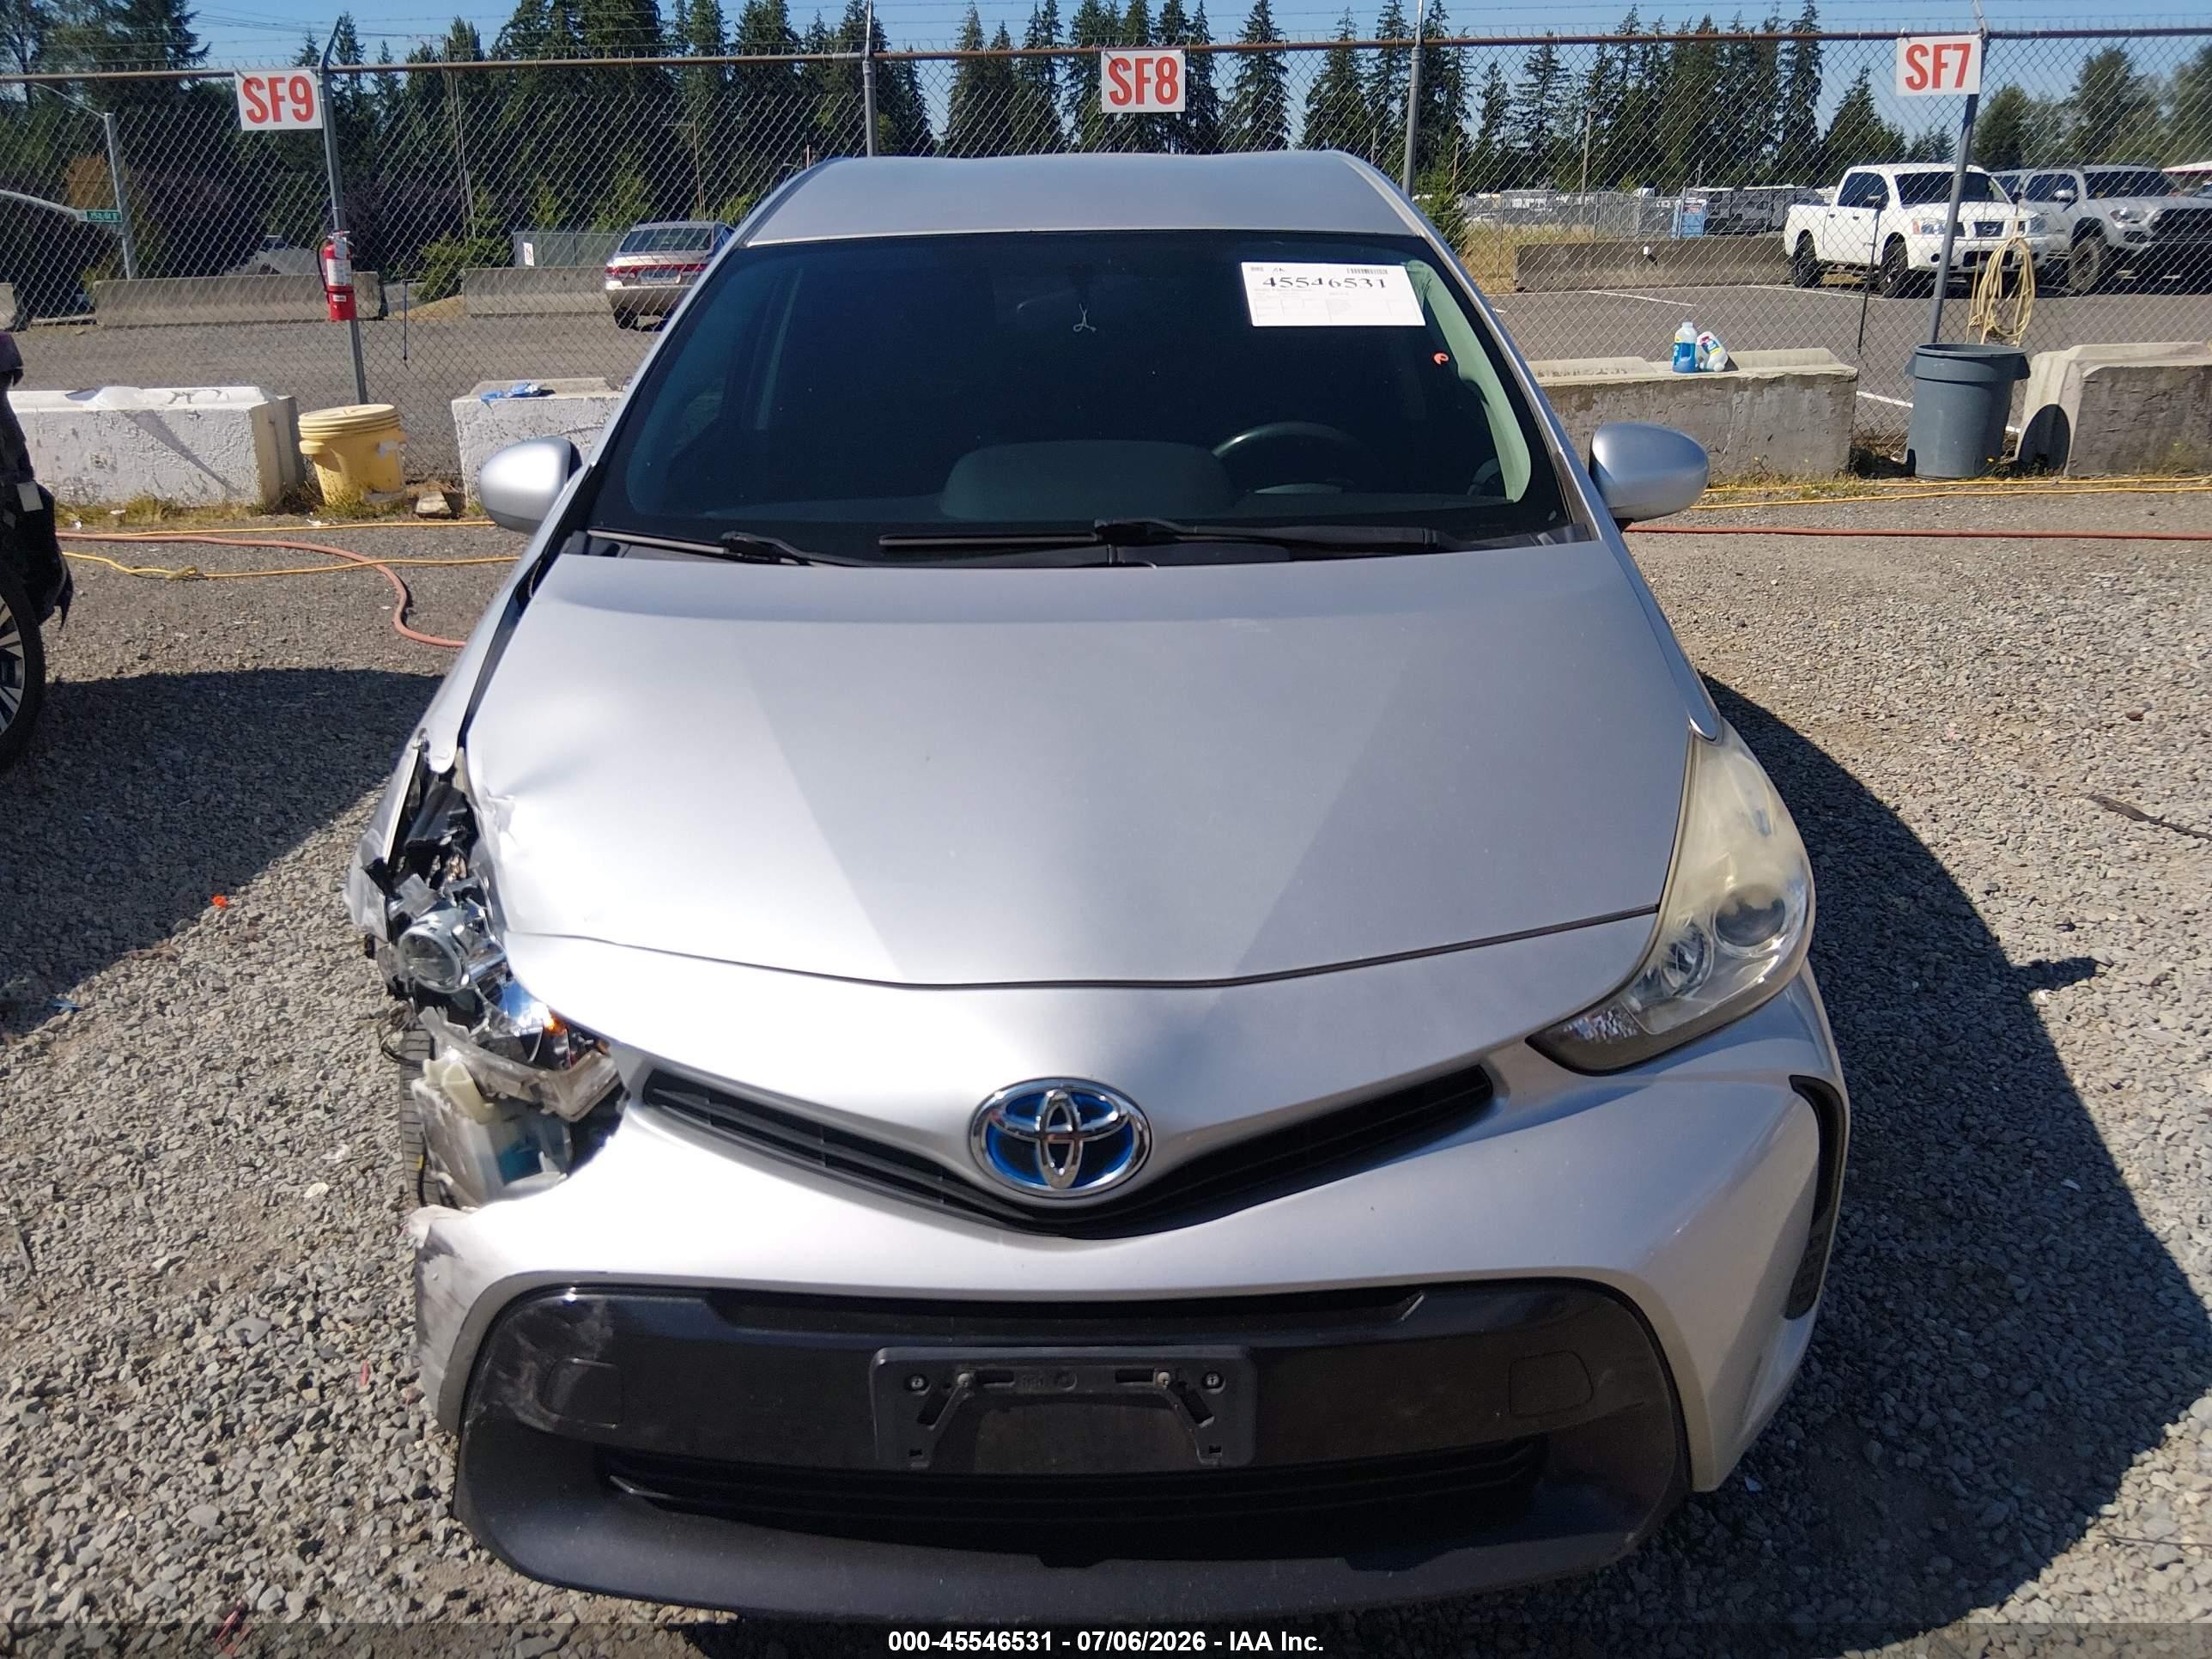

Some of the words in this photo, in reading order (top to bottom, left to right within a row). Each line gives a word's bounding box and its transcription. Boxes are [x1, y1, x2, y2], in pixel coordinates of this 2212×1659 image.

[1108, 56, 1179, 106] SF8
[1905, 43, 1972, 91] SF7
[242, 75, 314, 125] SF9
[1262, 276, 1387, 289] 45546531
